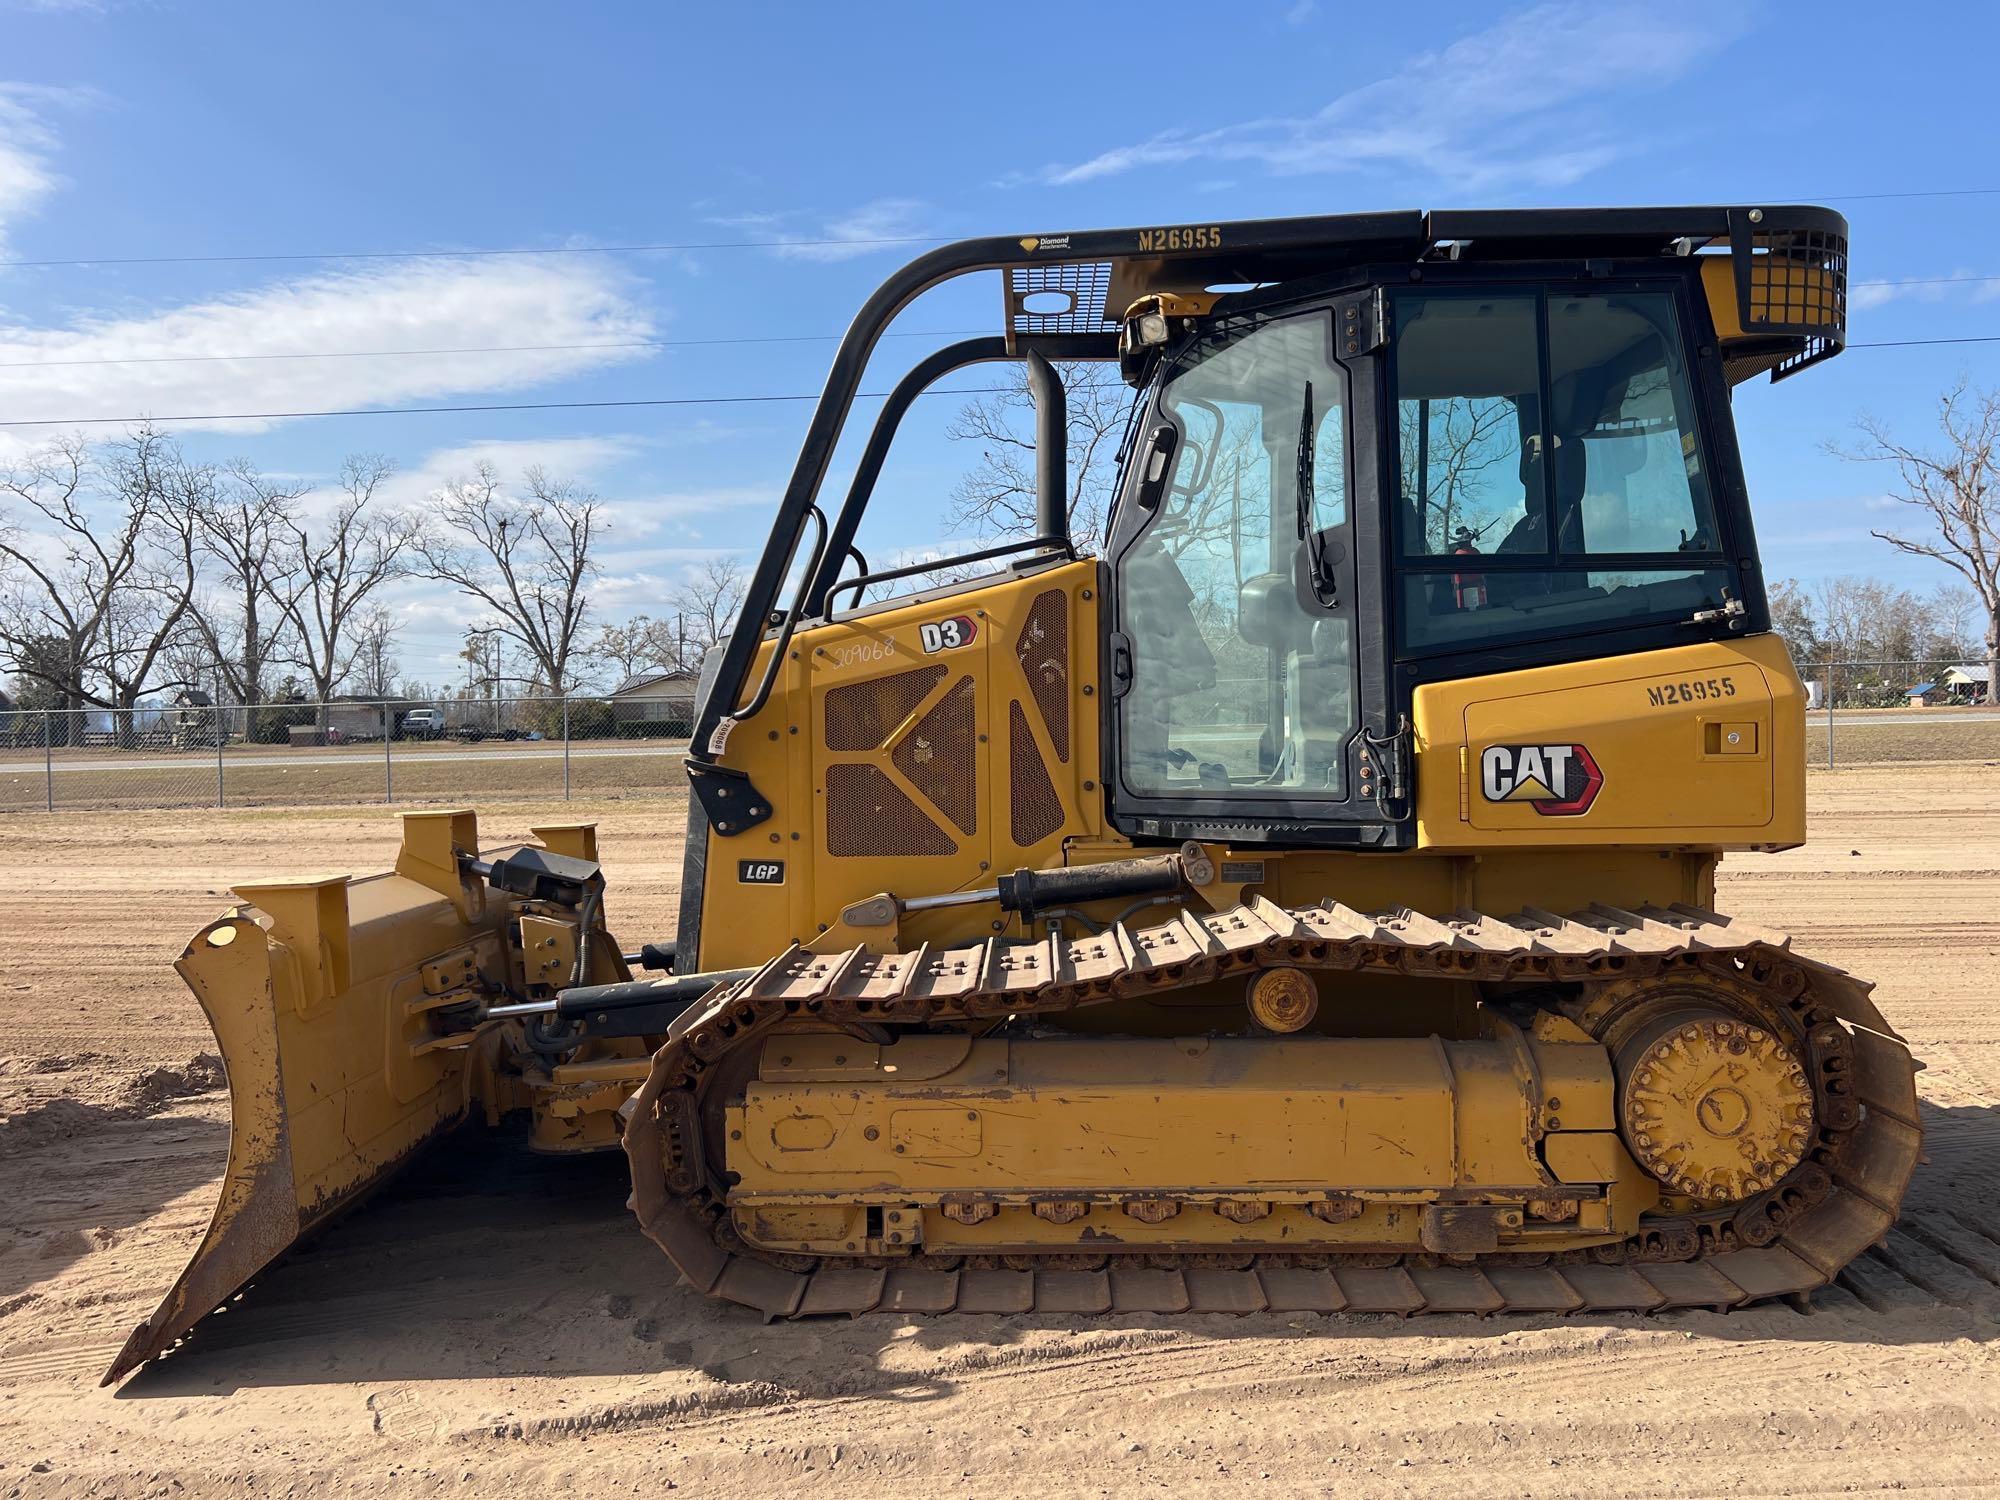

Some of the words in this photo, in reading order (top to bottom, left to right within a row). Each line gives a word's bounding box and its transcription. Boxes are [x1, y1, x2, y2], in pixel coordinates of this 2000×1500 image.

[1040, 236, 1070, 245] Diamond
[1139, 227, 1221, 251] M26955
[920, 620, 962, 653] D3
[833, 635, 895, 670] 209068
[1647, 676, 1736, 707] M26955
[715, 722, 731, 750] 209068
[1483, 746, 1573, 801] CAT
[746, 864, 779, 880] LGP
